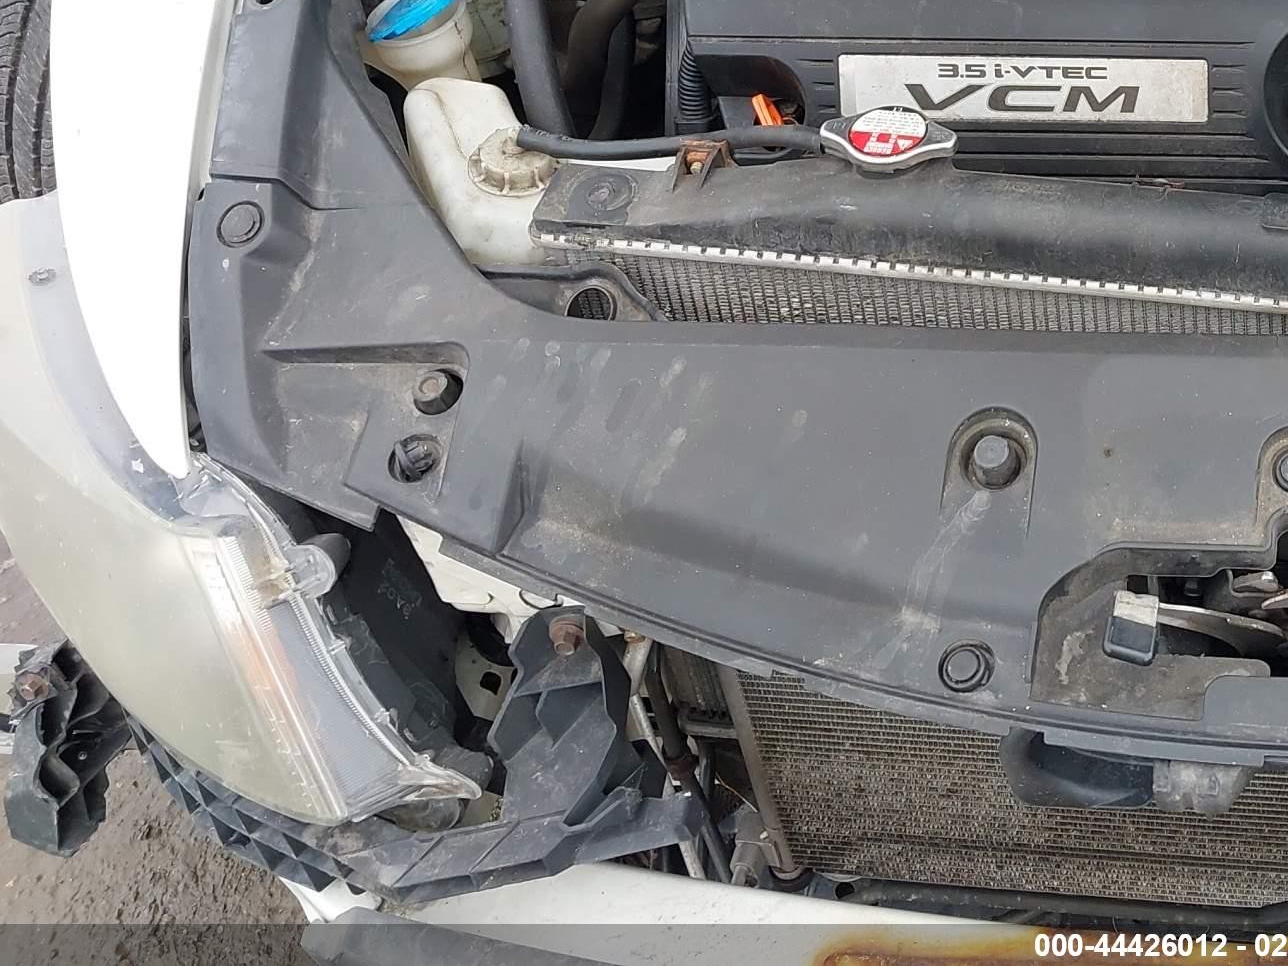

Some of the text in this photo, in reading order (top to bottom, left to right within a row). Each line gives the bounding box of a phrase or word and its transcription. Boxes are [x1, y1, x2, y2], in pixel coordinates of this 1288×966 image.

[937, 62, 1108, 79] 3.5 i-VTEC
[904, 82, 1141, 114] VCM
